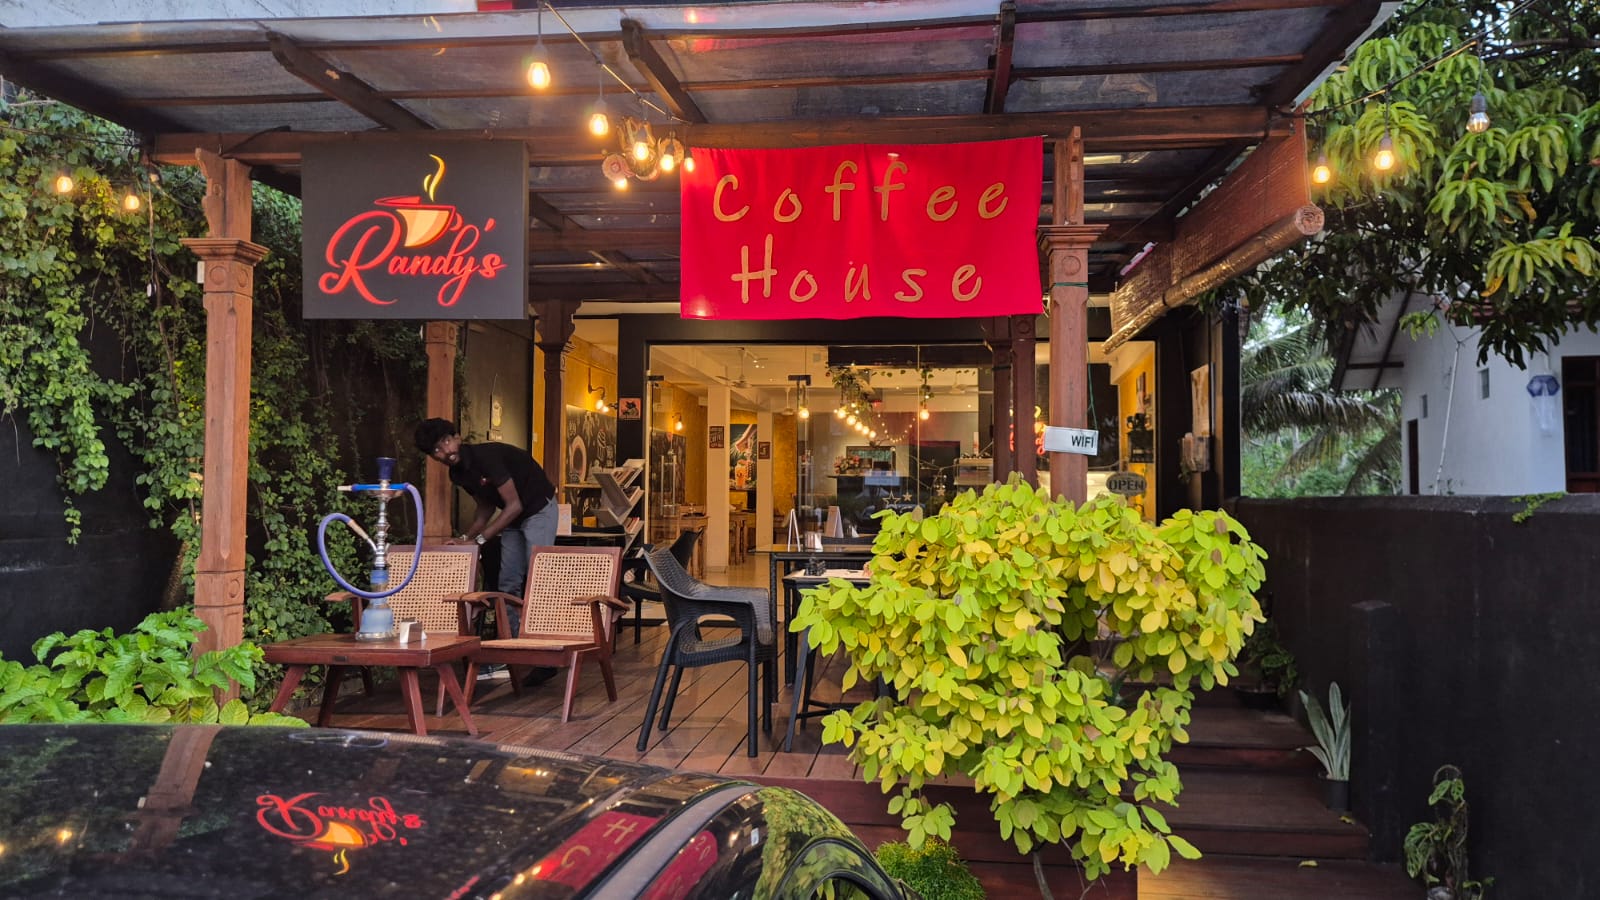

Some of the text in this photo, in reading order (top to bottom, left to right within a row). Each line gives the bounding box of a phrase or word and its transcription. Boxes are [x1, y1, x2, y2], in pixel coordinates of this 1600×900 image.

[712, 160, 1008, 223] Coffee
[318, 210, 507, 307] Randy's
[731, 233, 982, 304] House
[1071, 435, 1094, 448] WIFI
[1108, 479, 1144, 491] OPEN
